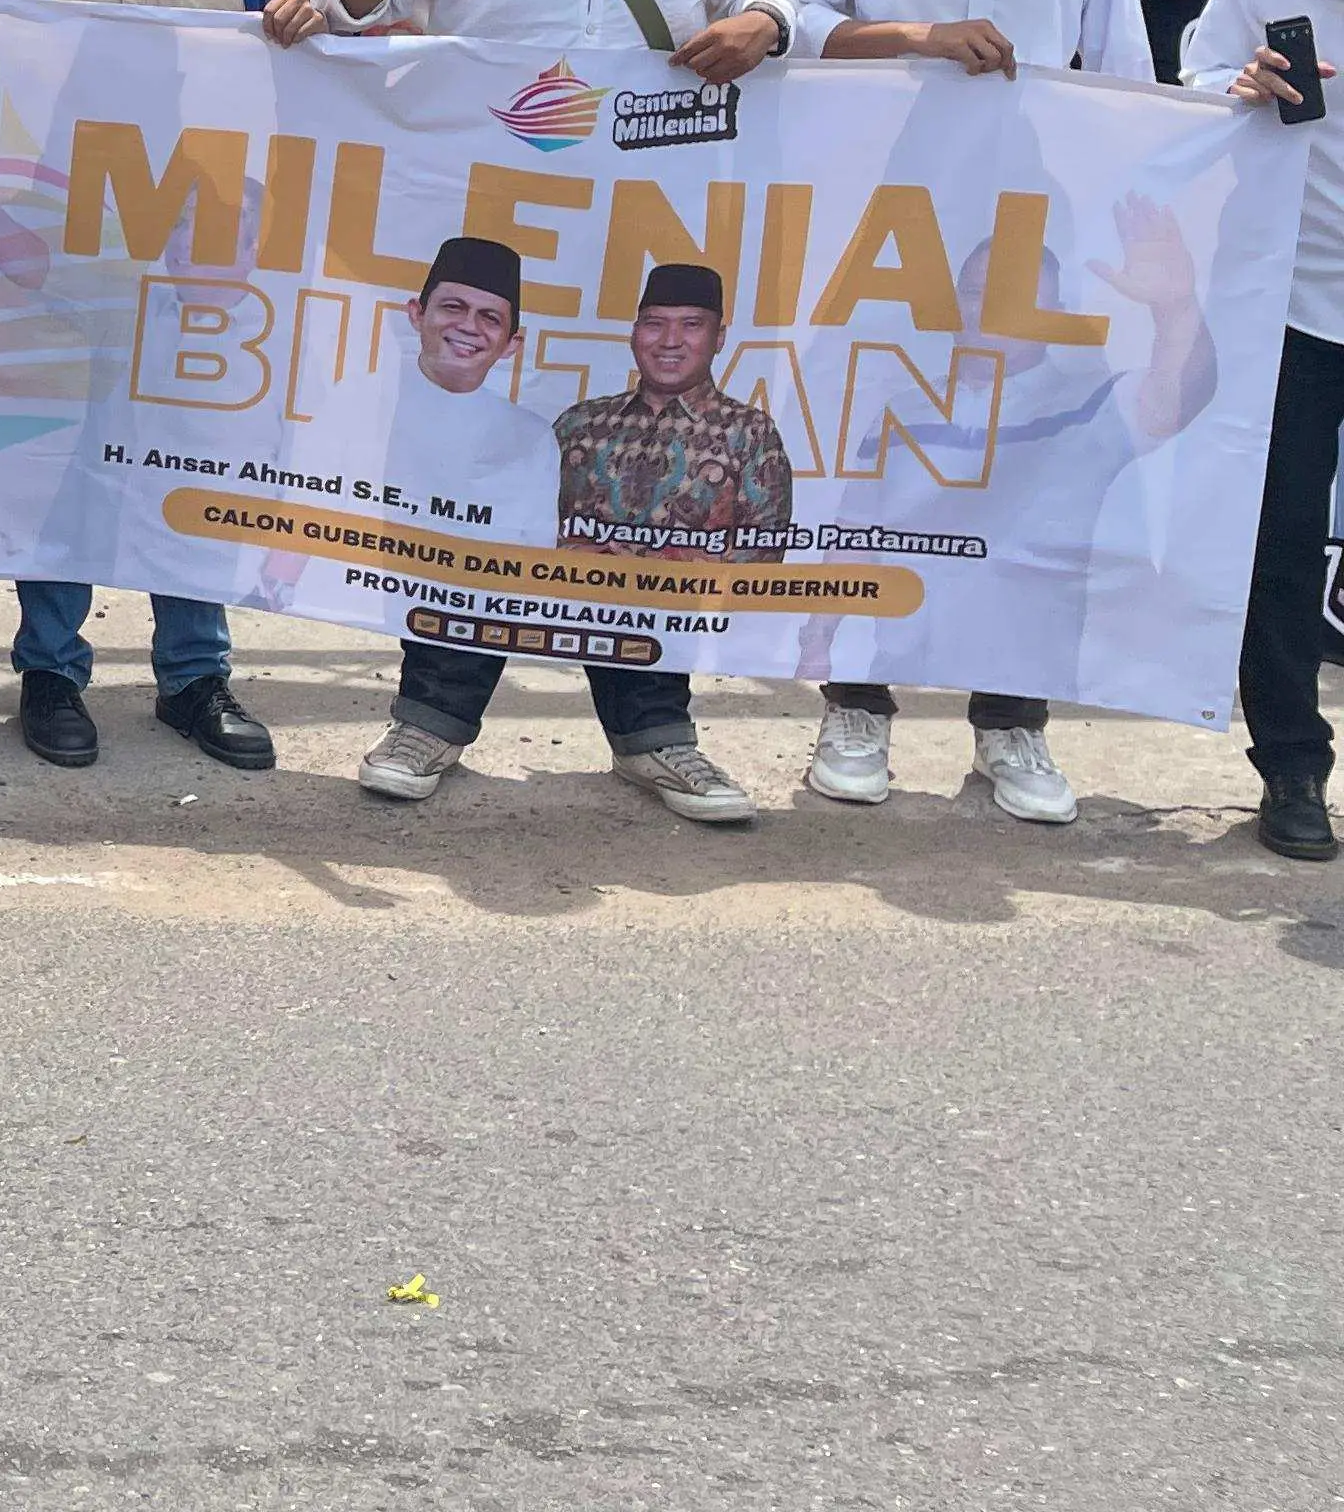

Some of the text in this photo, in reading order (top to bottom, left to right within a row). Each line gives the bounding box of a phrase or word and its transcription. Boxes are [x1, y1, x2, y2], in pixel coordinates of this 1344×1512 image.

[614, 108, 728, 143] Millenial
[615, 83, 731, 116] Centre Of
[61, 119, 1110, 347] MILENIAL
[103, 443, 493, 525] H. Ansar Ahmad S.E., M.M
[204, 505, 880, 600] CALON GUBERNUR DAN CALON WAKIL GUBERNUR
[735, 526, 812, 549] Haris
[818, 527, 988, 558] Pratamura
[346, 568, 730, 634] PROVINSI KEPULAUAN RIAU
